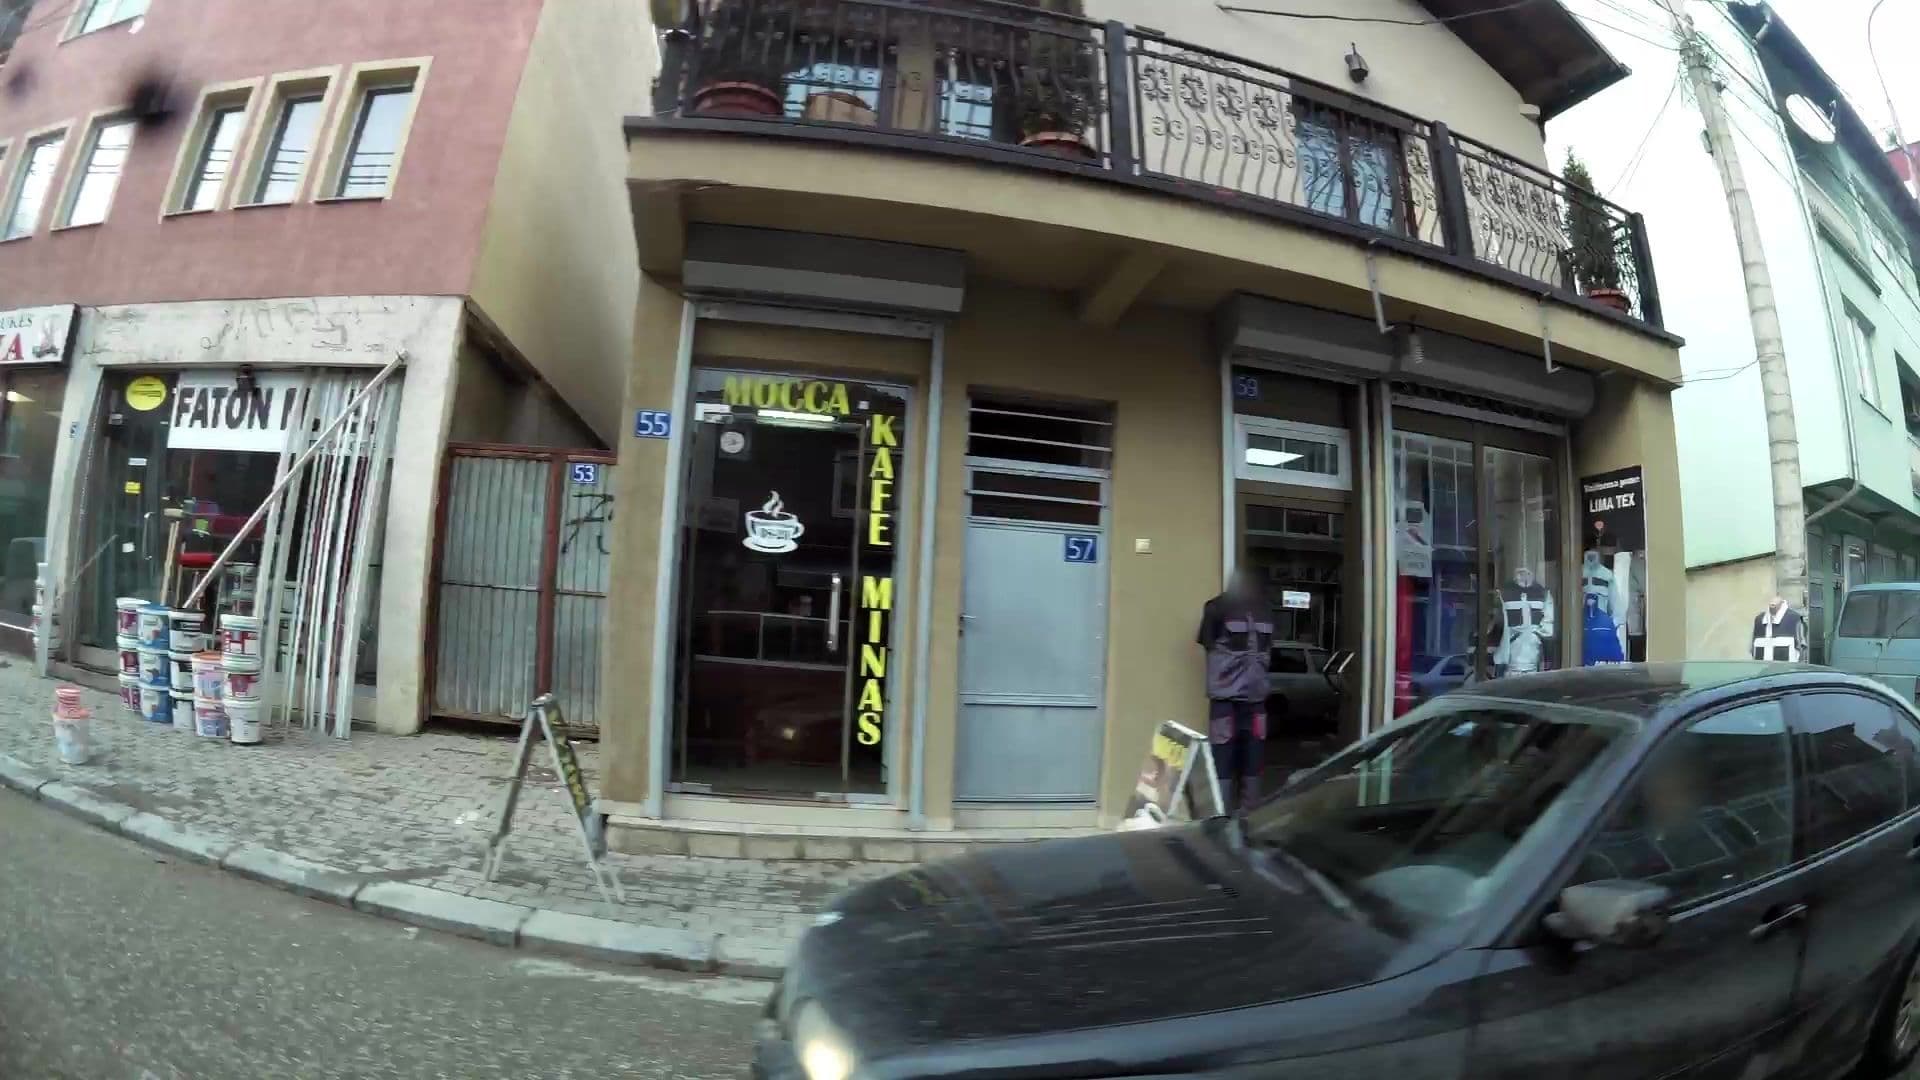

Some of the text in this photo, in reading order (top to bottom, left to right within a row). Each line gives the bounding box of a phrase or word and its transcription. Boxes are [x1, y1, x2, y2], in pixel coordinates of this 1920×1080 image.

[174, 386, 274, 430] FATON
[723, 376, 850, 415] MOCCA
[637, 411, 668, 436] 55
[573, 464, 595, 482] 53
[1589, 492, 1636, 512] LIMA TEX
[1068, 537, 1093, 560] 57
[857, 414, 898, 745] KAFE MINAS
